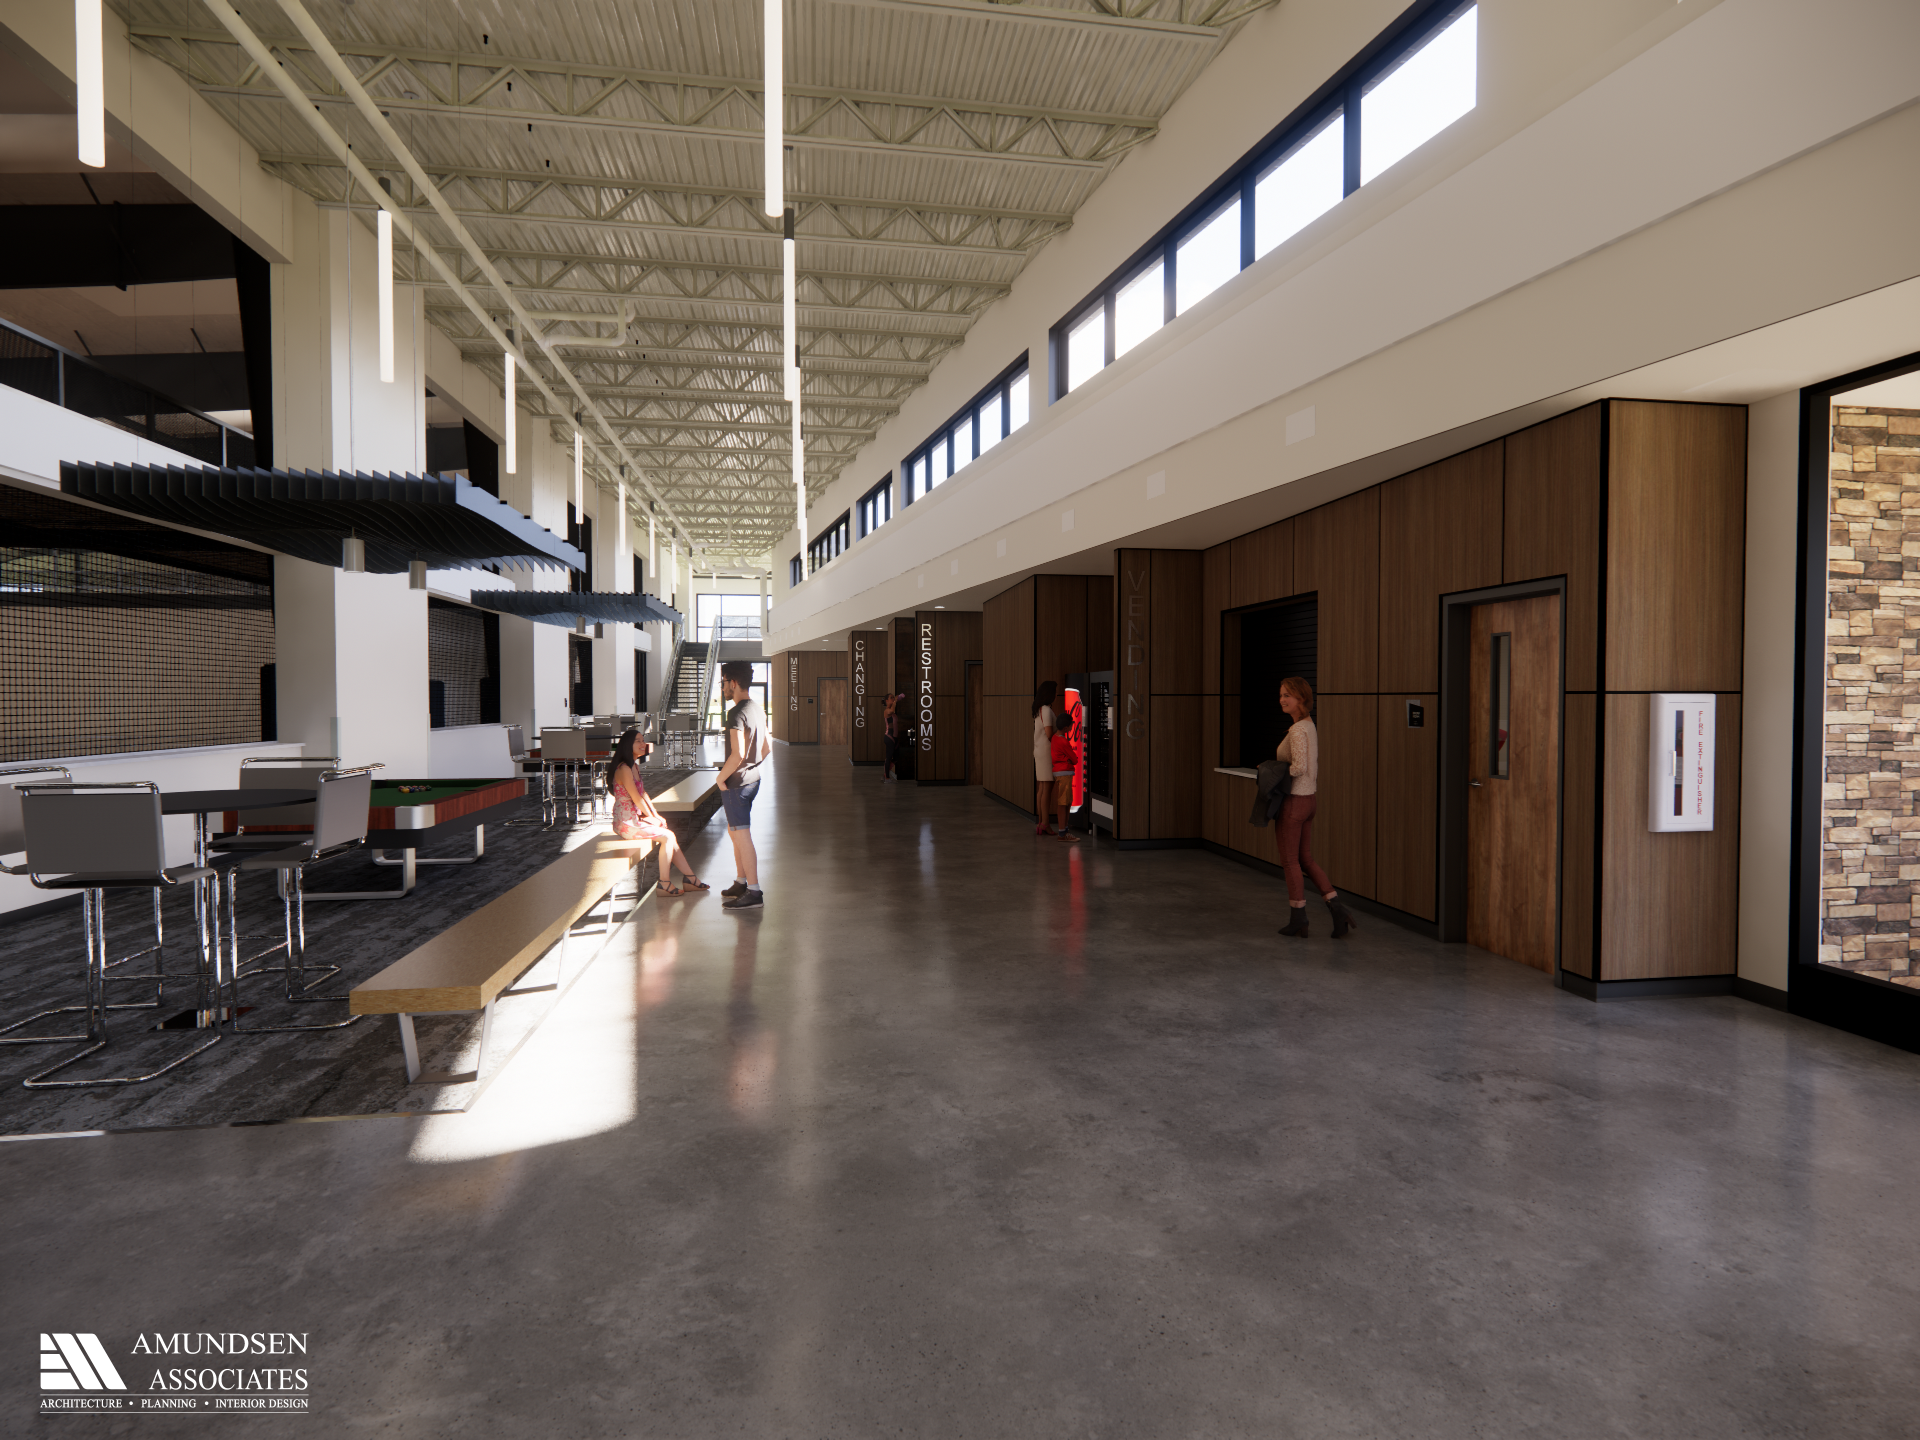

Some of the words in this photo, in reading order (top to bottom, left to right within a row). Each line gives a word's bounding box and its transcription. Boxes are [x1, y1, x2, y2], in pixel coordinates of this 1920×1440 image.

[790, 657, 798, 711] MEETING
[855, 640, 865, 728] CHANGING
[920, 623, 933, 751] RESTROOMS
[1125, 570, 1146, 740] VENDING
